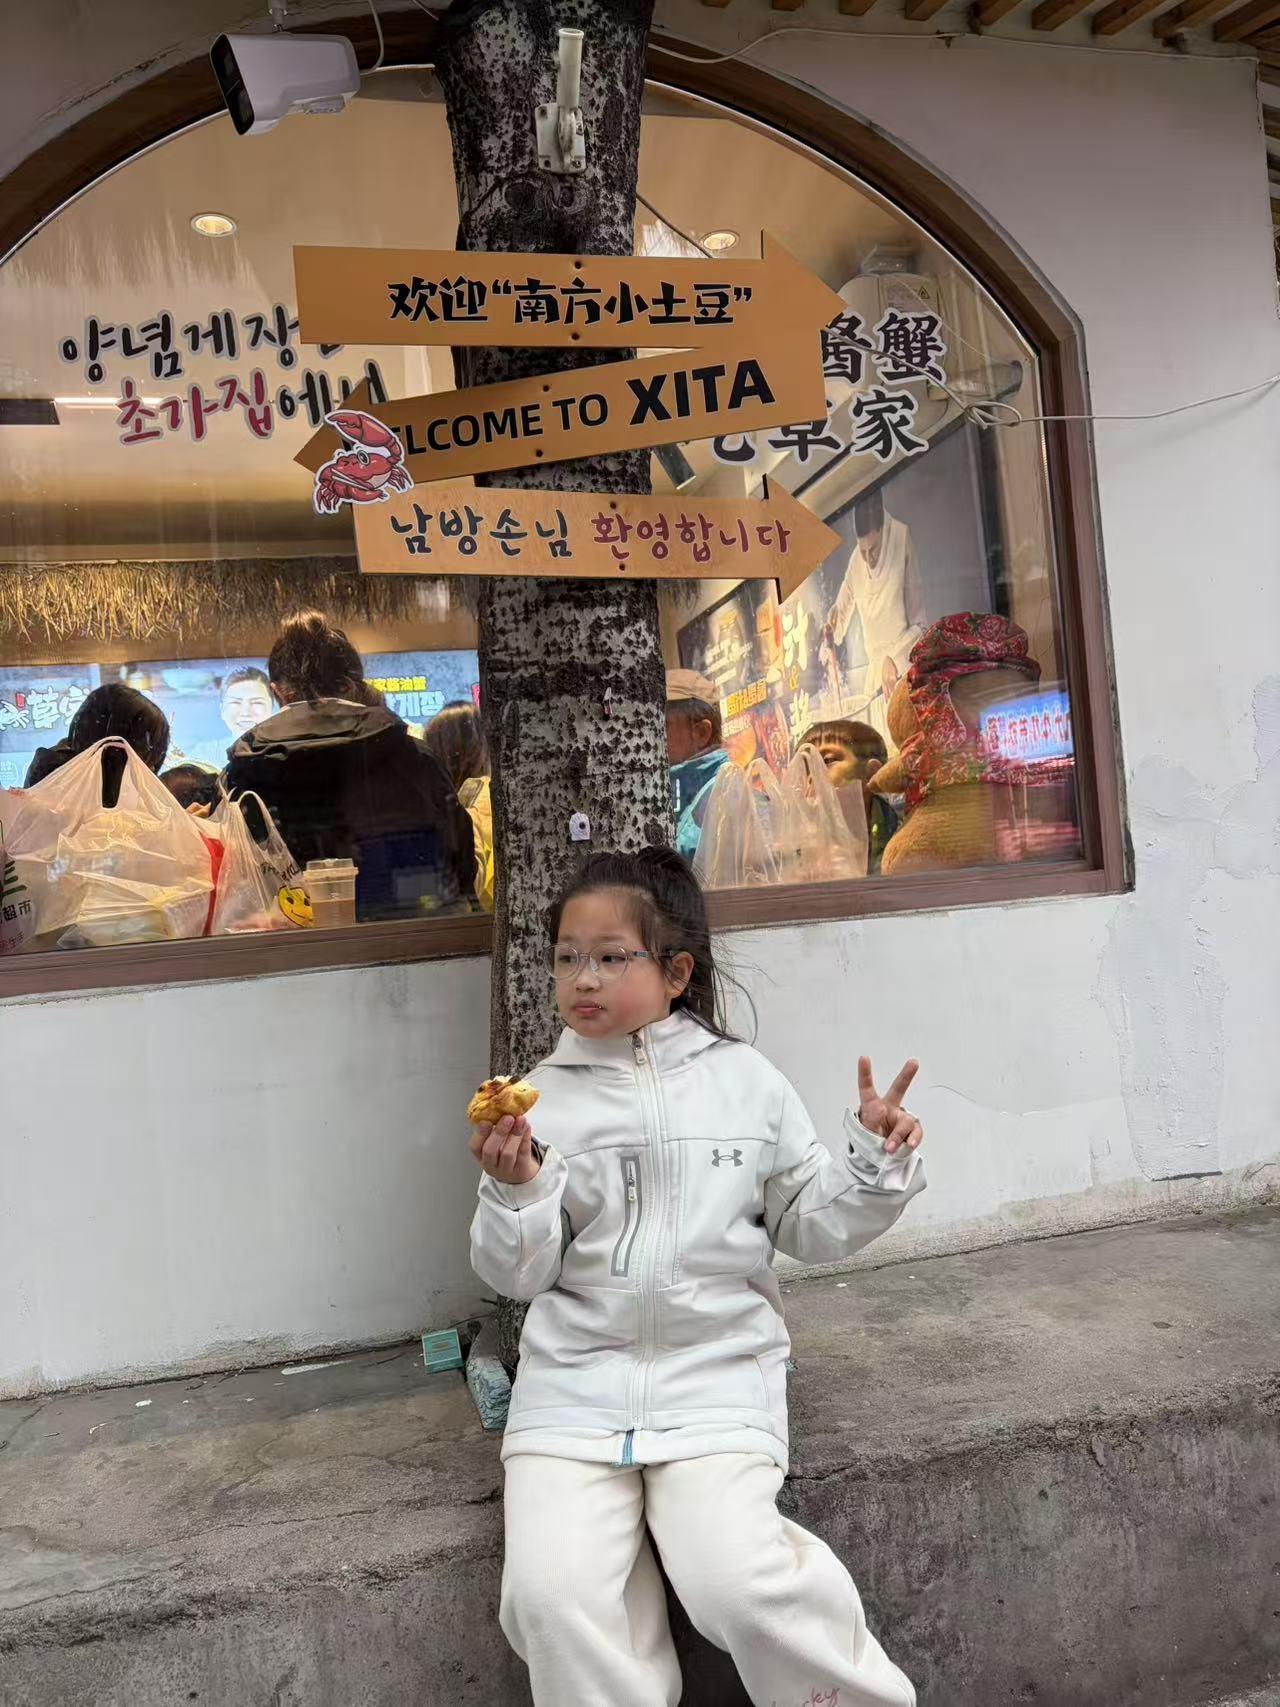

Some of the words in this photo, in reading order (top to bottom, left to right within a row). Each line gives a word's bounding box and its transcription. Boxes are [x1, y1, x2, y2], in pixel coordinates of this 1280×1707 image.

[387, 275, 752, 325] 欢迎“南方小土豆”
[61, 303, 342, 383] 양념게장
[343, 403, 543, 458] LCOME
[550, 394, 609, 431] TO
[625, 358, 775, 426] XITA
[390, 503, 573, 558] 남방손님
[592, 511, 791, 563] 환영합니다
